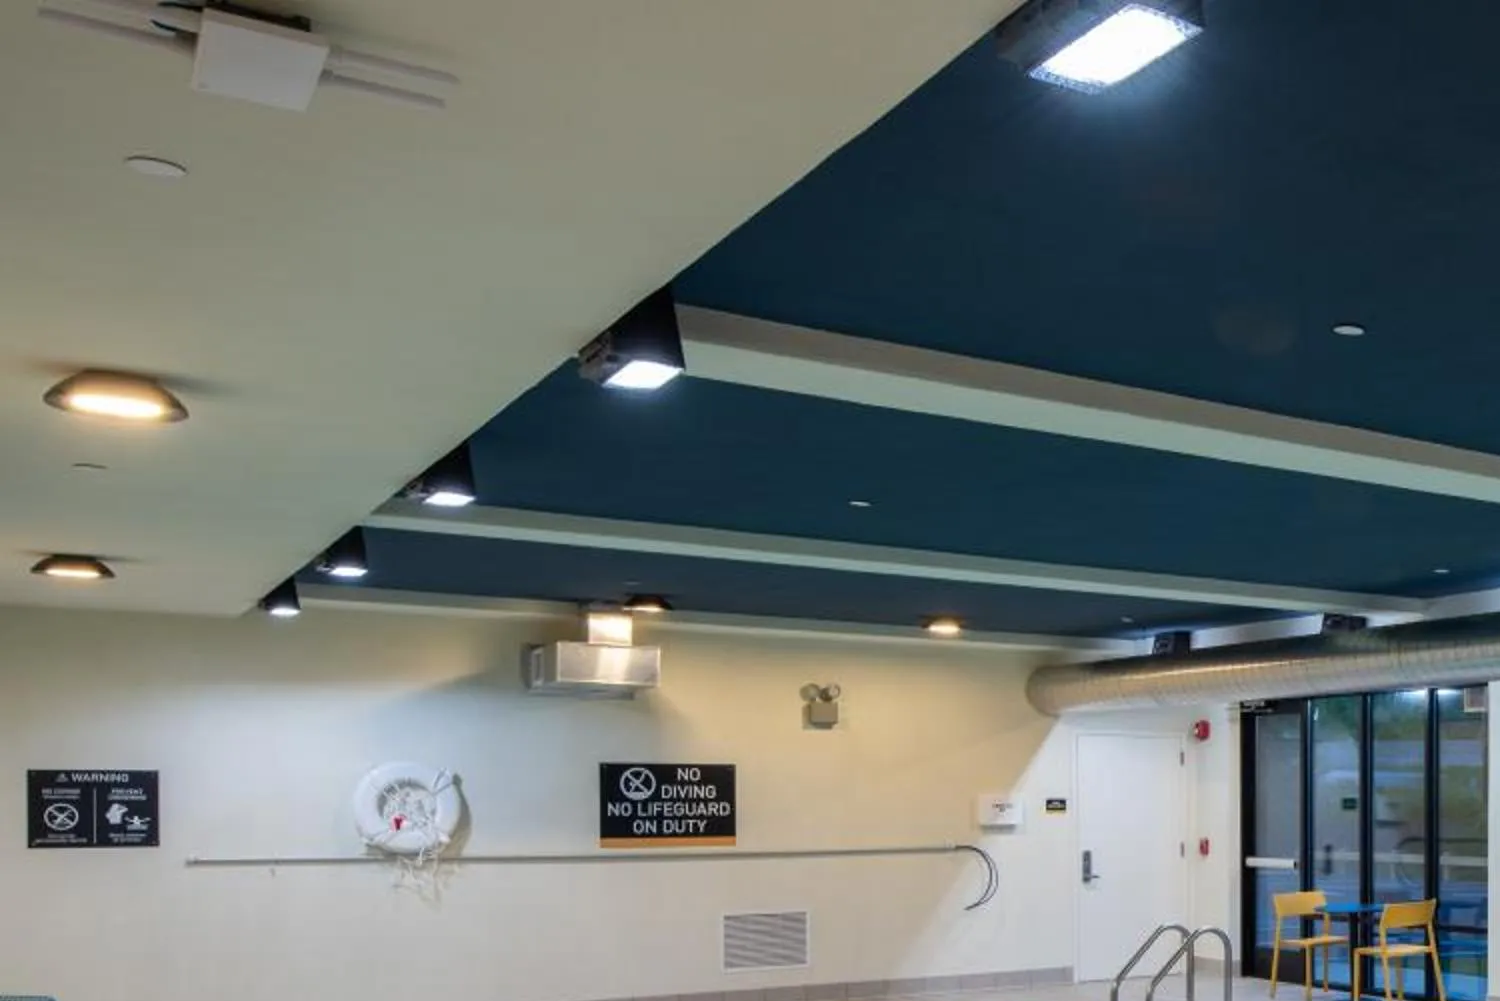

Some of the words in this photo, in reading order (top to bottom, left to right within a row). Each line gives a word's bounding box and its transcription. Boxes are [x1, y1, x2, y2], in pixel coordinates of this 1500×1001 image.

[71, 773, 129, 783] WARNING
[677, 768, 701, 781] NO
[661, 784, 717, 799] DIVING
[607, 802, 632, 817] NO
[637, 802, 731, 817] LIFEGUARD
[633, 819, 657, 834] ON
[663, 819, 707, 834] DUTY
